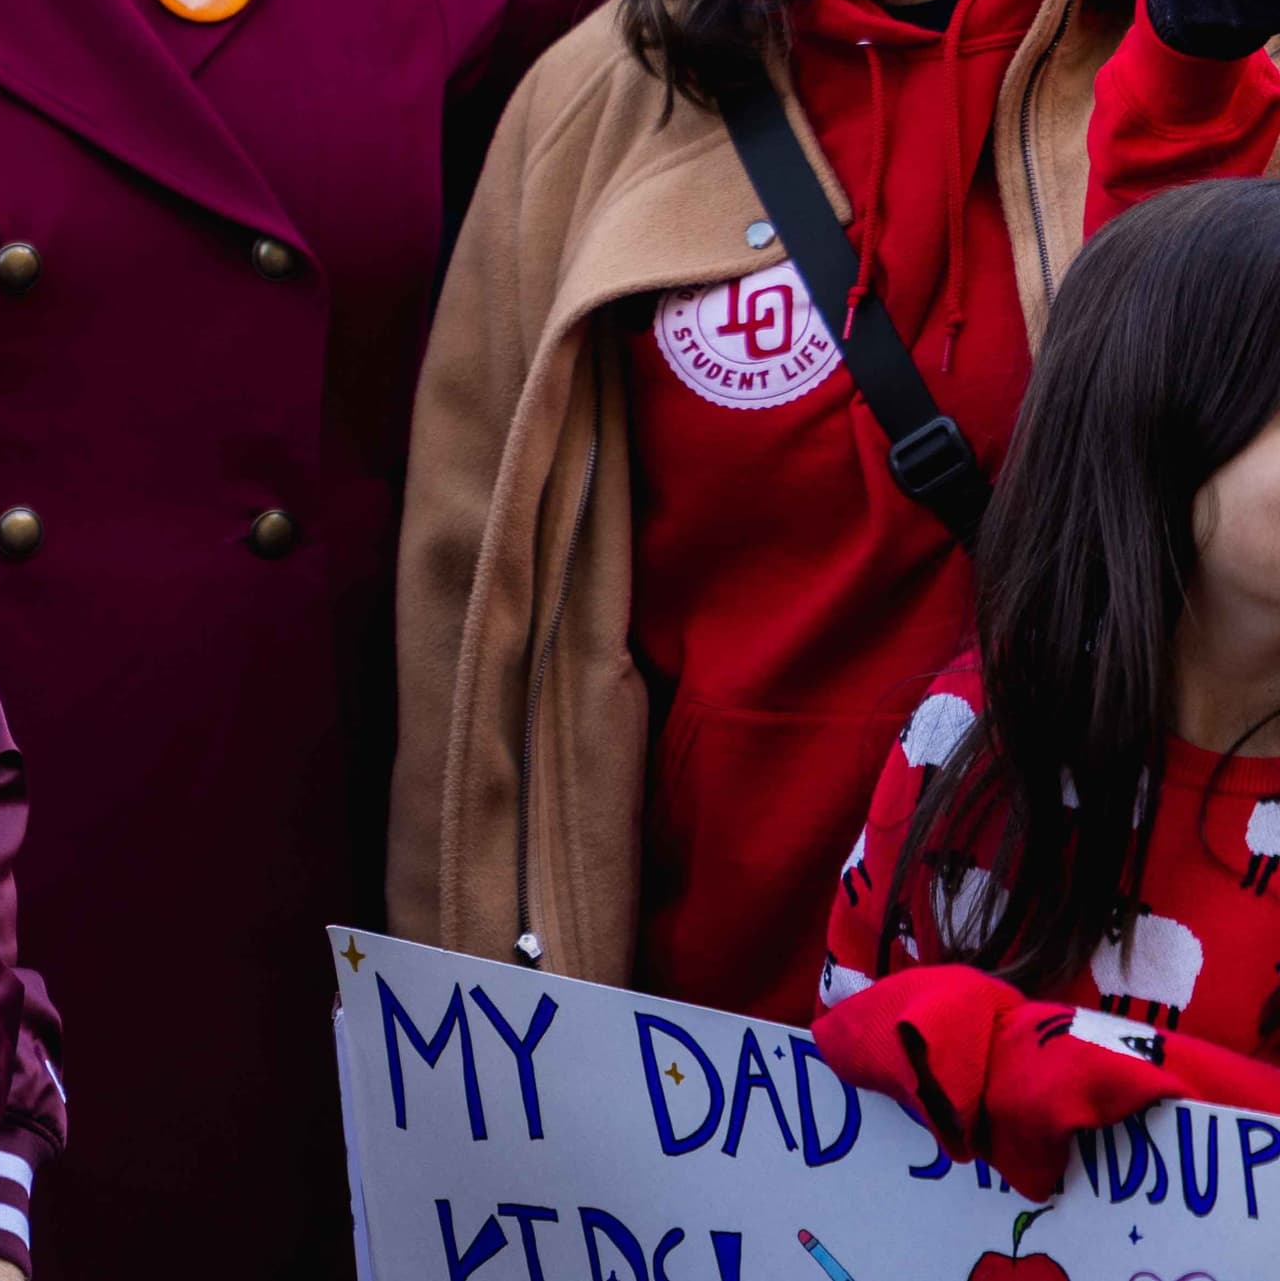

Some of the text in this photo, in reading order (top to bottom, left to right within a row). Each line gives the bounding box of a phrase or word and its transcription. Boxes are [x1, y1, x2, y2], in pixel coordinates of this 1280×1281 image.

[673, 327, 829, 390] STUDENT LIFE
[375, 972, 559, 1141] MY
[634, 1011, 862, 1168] DAD
